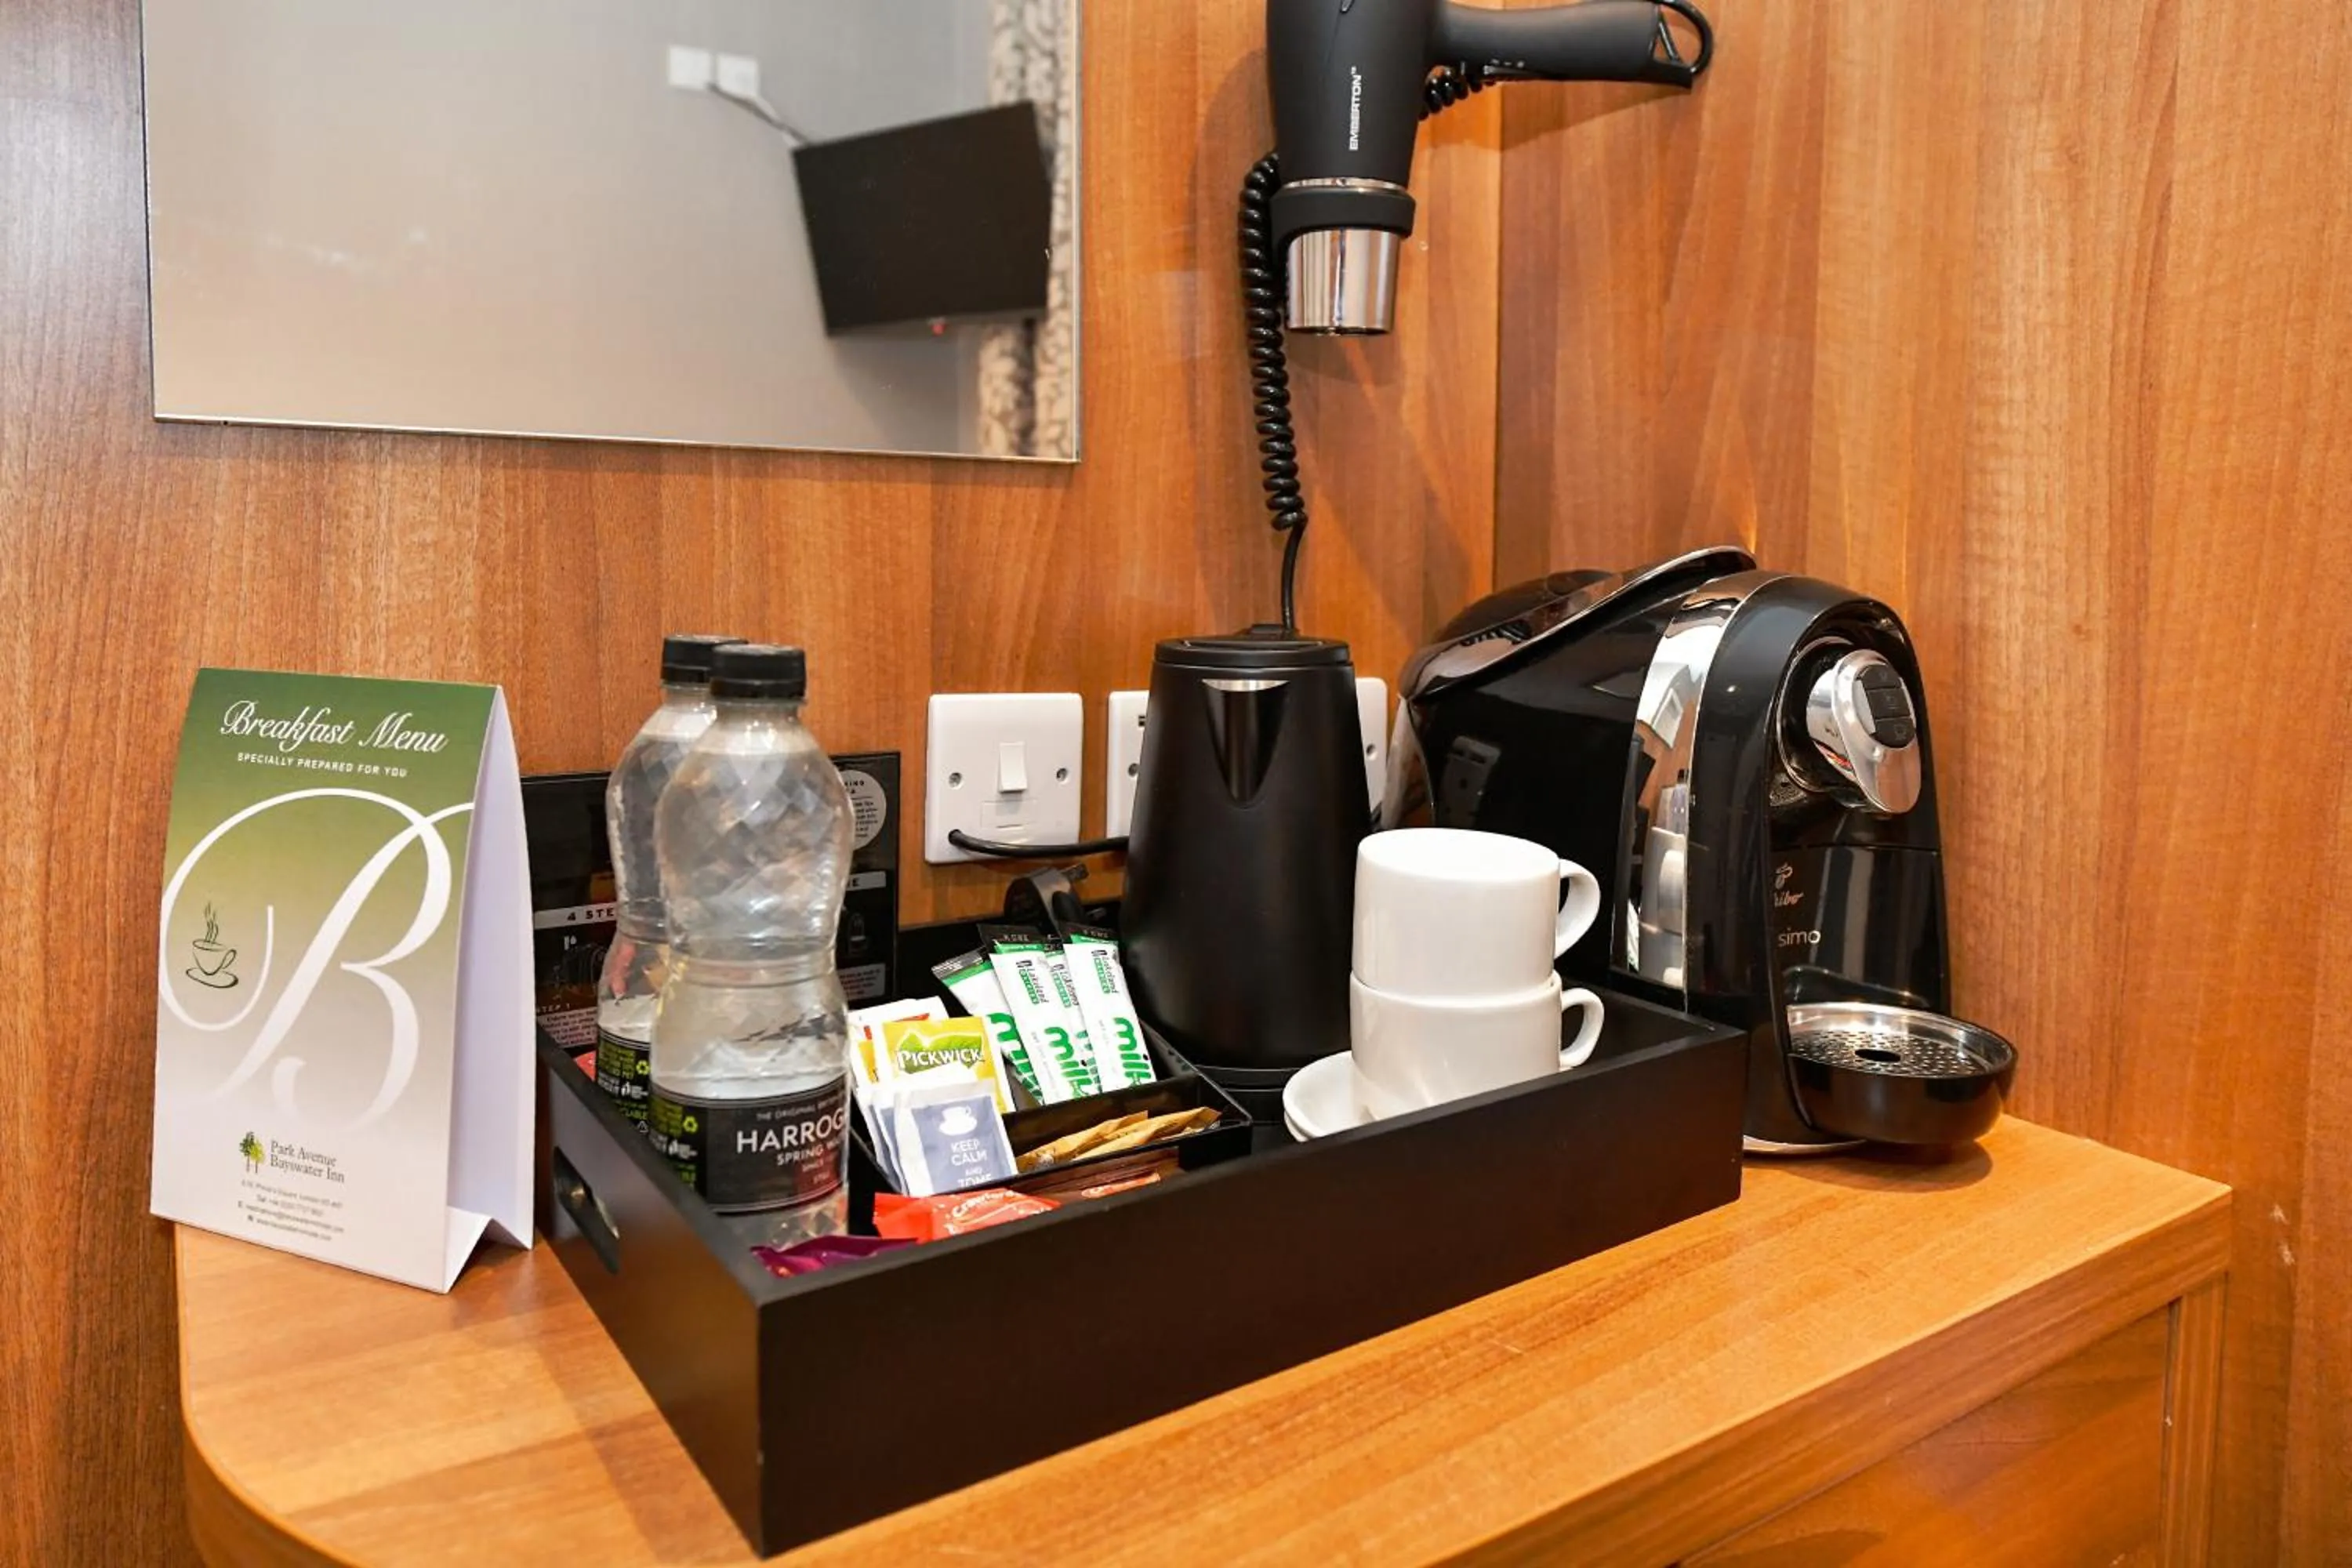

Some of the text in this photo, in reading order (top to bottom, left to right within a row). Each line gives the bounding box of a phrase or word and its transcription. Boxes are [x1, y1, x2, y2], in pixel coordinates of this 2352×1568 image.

[1349, 74, 1362, 151] EMBERTON
[220, 699, 449, 753] Breakfast Menu
[238, 752, 408, 779] SPECIALLY PREPARED FOR YOU
[586, 908, 615, 920] STE
[1777, 927, 1821, 948] simo
[898, 1048, 982, 1071] PICKWICK
[737, 1107, 844, 1154] HARROG
[270, 1140, 337, 1167] Park Avenue
[777, 1145, 824, 1166] SPRING
[951, 1138, 980, 1152] KEEP
[270, 1153, 345, 1183] Bayswater Inn
